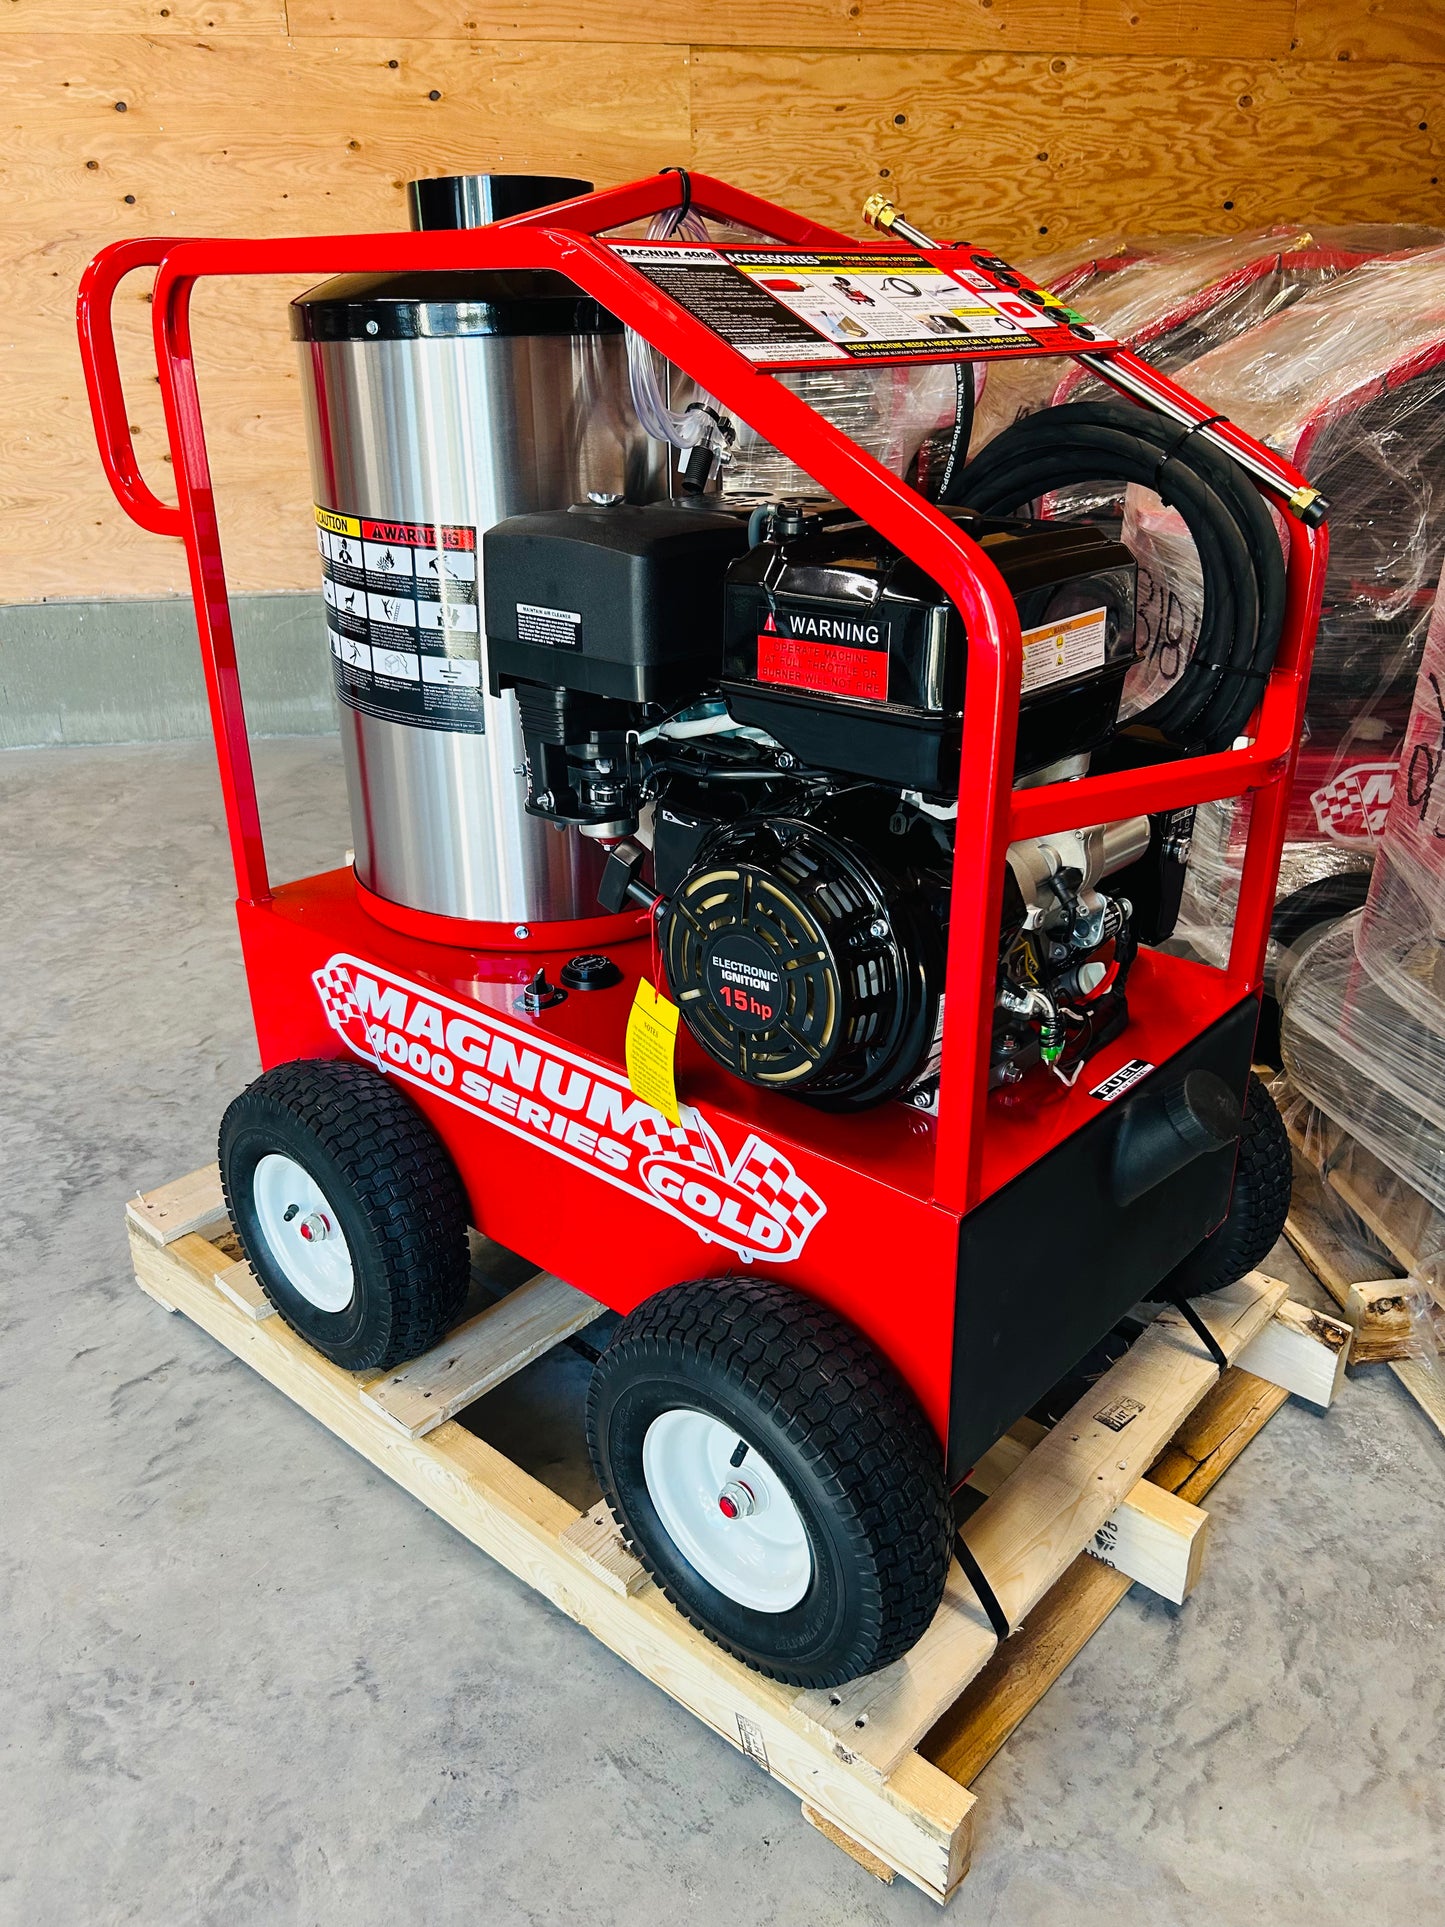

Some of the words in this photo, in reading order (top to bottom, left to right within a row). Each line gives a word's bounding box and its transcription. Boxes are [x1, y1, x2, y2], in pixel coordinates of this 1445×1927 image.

[615, 248, 682, 258] MAGNUM
[684, 250, 718, 259] 4000
[725, 253, 821, 265] ACCESSORIES
[956, 382, 964, 424] Washer
[950, 426, 962, 452] Hose
[318, 511, 348, 532] CAUTION
[522, 606, 543, 614] MAINTAIN
[551, 611, 571, 619] CLEANER
[789, 615, 879, 644] WARNING
[773, 641, 820, 657] OPERATE
[824, 649, 868, 664] MACHINE
[765, 654, 776, 663] AT
[780, 656, 802, 669] FULL
[808, 659, 858, 677] THROTTLE
[863, 668, 878, 679] OR
[762, 667, 801, 680] BURNER
[805, 674, 828, 686] WILL
[831, 677, 851, 690] NOT
[856, 682, 880, 694] FIRE
[712, 955, 778, 982] ELECTRONIC
[721, 969, 770, 992] IGNITION
[355, 973, 666, 1136] MAGNUM
[1098, 1065, 1144, 1095] FUEL
[1128, 1068, 1147, 1084] DIESEL
[365, 1023, 454, 1086] 4000
[459, 1070, 632, 1171] SERIES
[647, 1164, 784, 1250] GOLD
